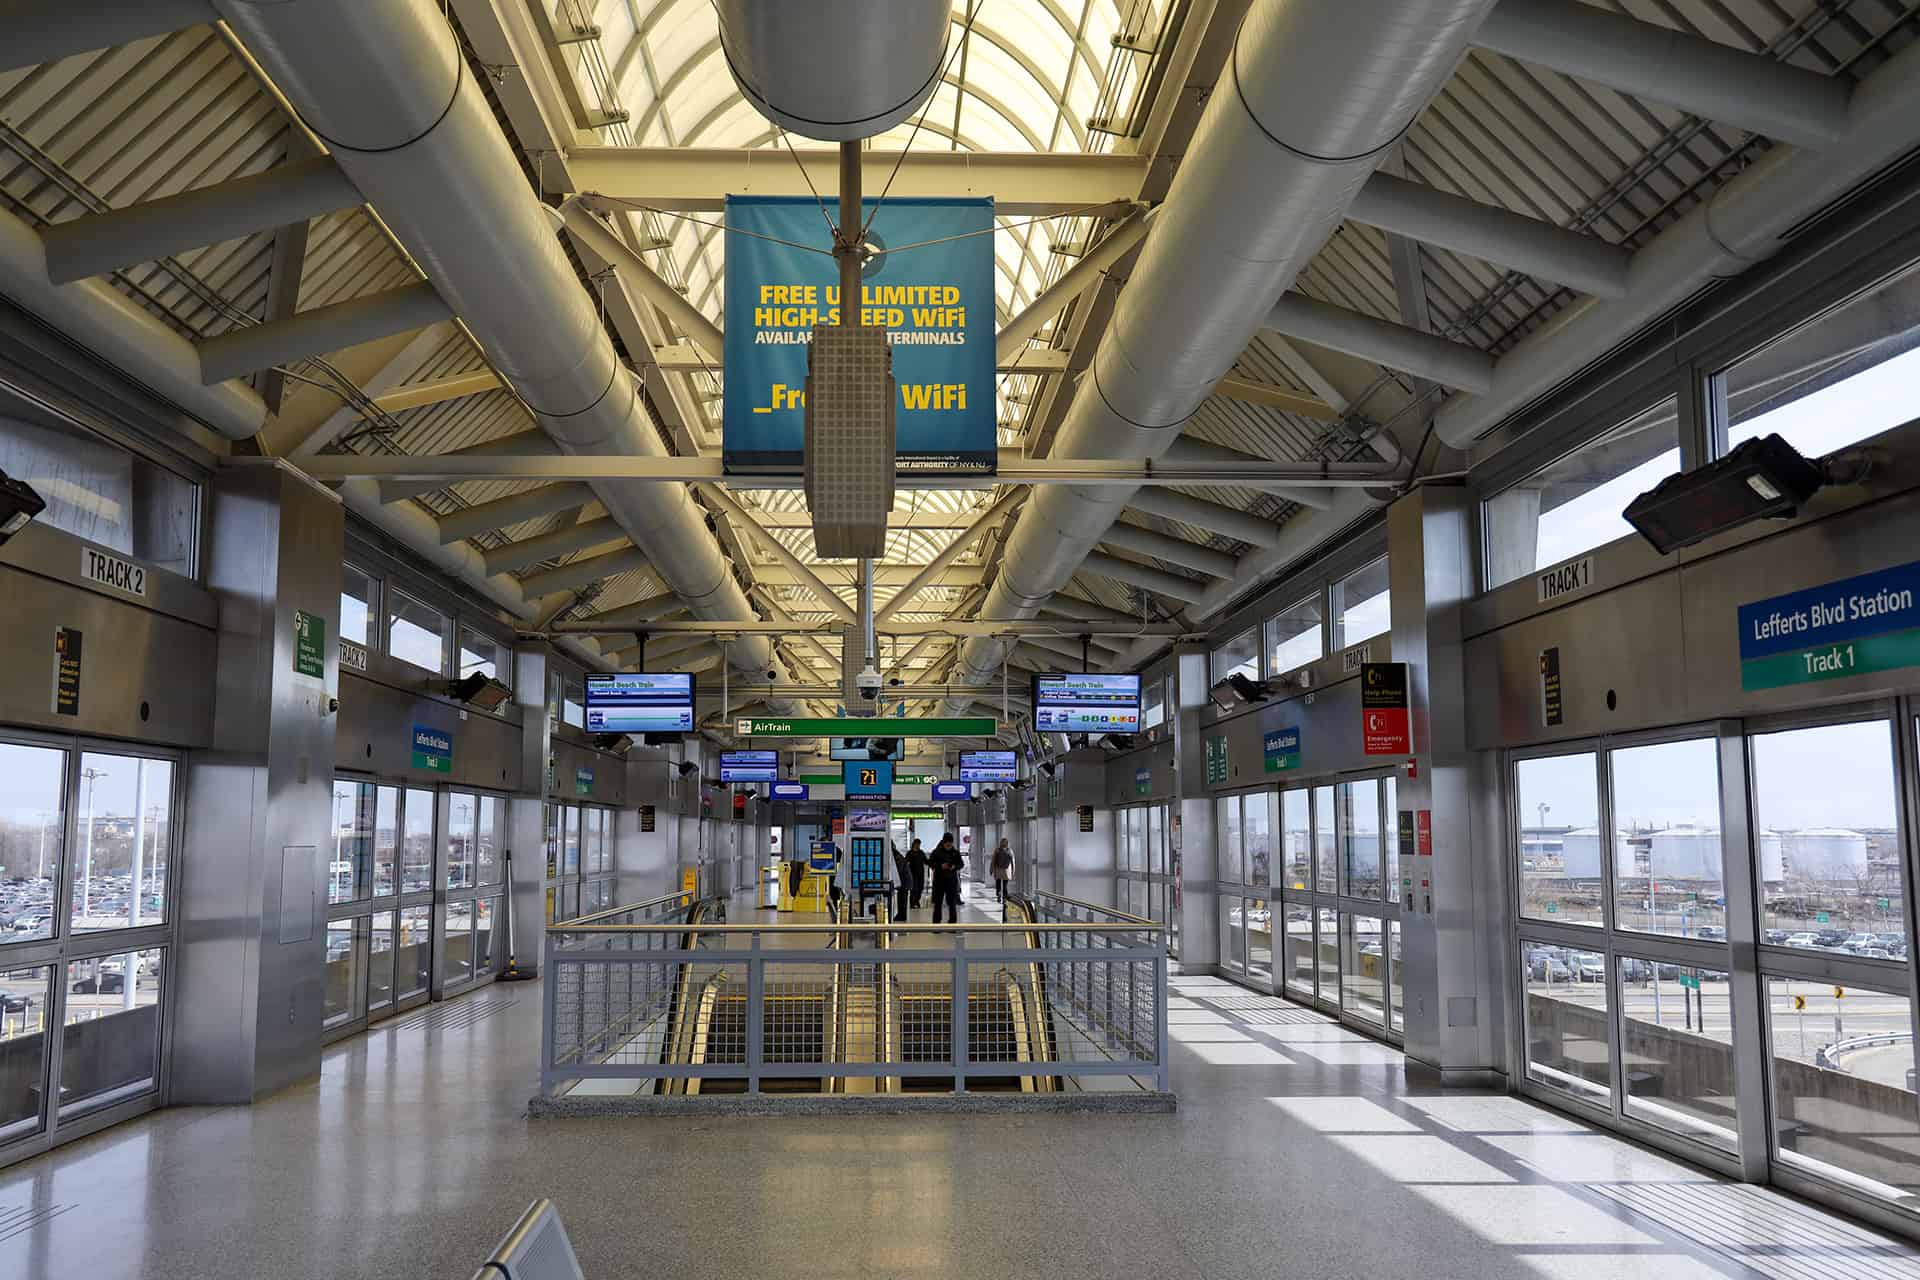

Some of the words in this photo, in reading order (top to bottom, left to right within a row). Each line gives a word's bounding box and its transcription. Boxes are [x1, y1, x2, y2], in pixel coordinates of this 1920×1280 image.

[760, 285, 817, 305] FREE
[825, 285, 961, 306] ULIMITED
[755, 307, 904, 328] HIGH-SEED
[912, 306, 966, 328] WiFi
[886, 332, 965, 345] TERMINALS
[902, 383, 967, 410] WiFi
[88, 551, 133, 590] TRACK
[134, 577, 144, 594] 2
[1541, 563, 1580, 600] TRACK
[1582, 559, 1589, 585] 1
[1754, 609, 1808, 641] Lefferts
[1811, 601, 1846, 629] Blvd
[1849, 588, 1913, 621] Station
[339, 643, 358, 669] TRACK
[360, 651, 367, 669] 2
[1345, 646, 1364, 673] TRACK
[1804, 650, 1842, 674] Track
[1846, 645, 1855, 667] 1
[589, 681, 615, 689] Howard
[617, 681, 637, 689] Beach
[639, 681, 655, 689] Train
[754, 723, 791, 733] AirTrain
